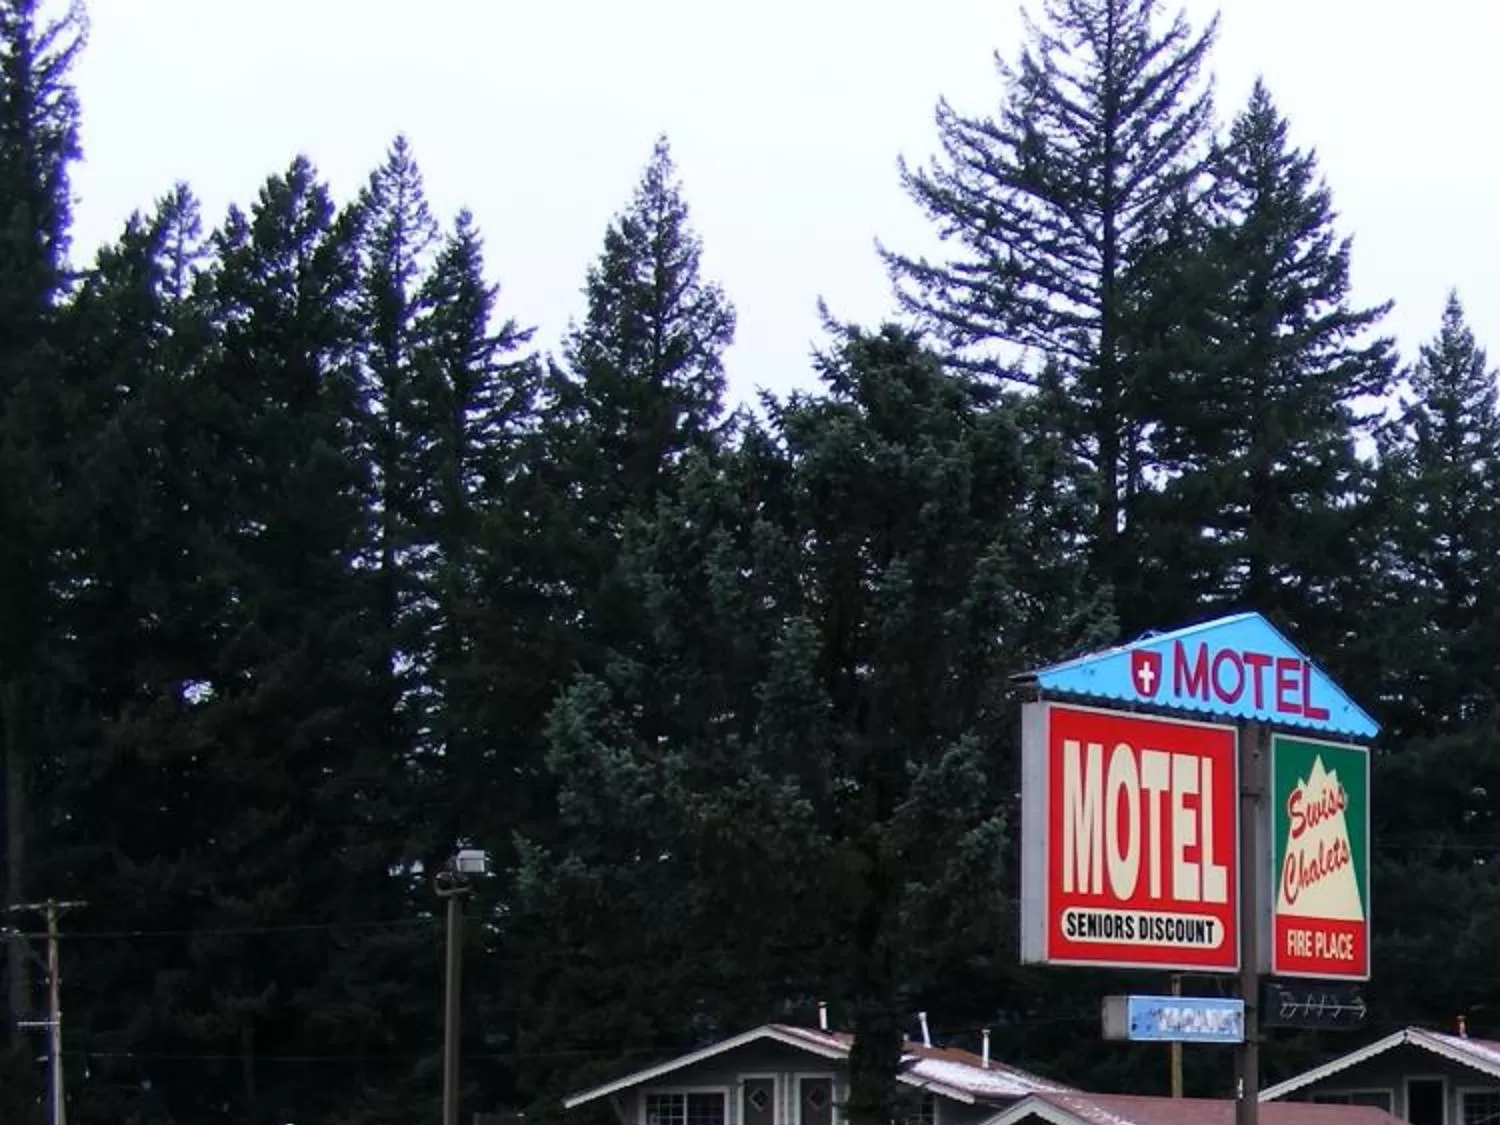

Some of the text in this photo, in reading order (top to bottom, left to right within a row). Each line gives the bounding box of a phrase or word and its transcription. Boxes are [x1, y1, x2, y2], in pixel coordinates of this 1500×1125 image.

[1174, 640, 1330, 721] MOTEL
[1063, 739, 1228, 903] MOTEL
[1287, 783, 1347, 840] Swiss
[1283, 836, 1350, 906] Chalets
[1066, 911, 1215, 945] SENIORS DISCOUNT
[1287, 929, 1354, 961] FIRE PLACE
